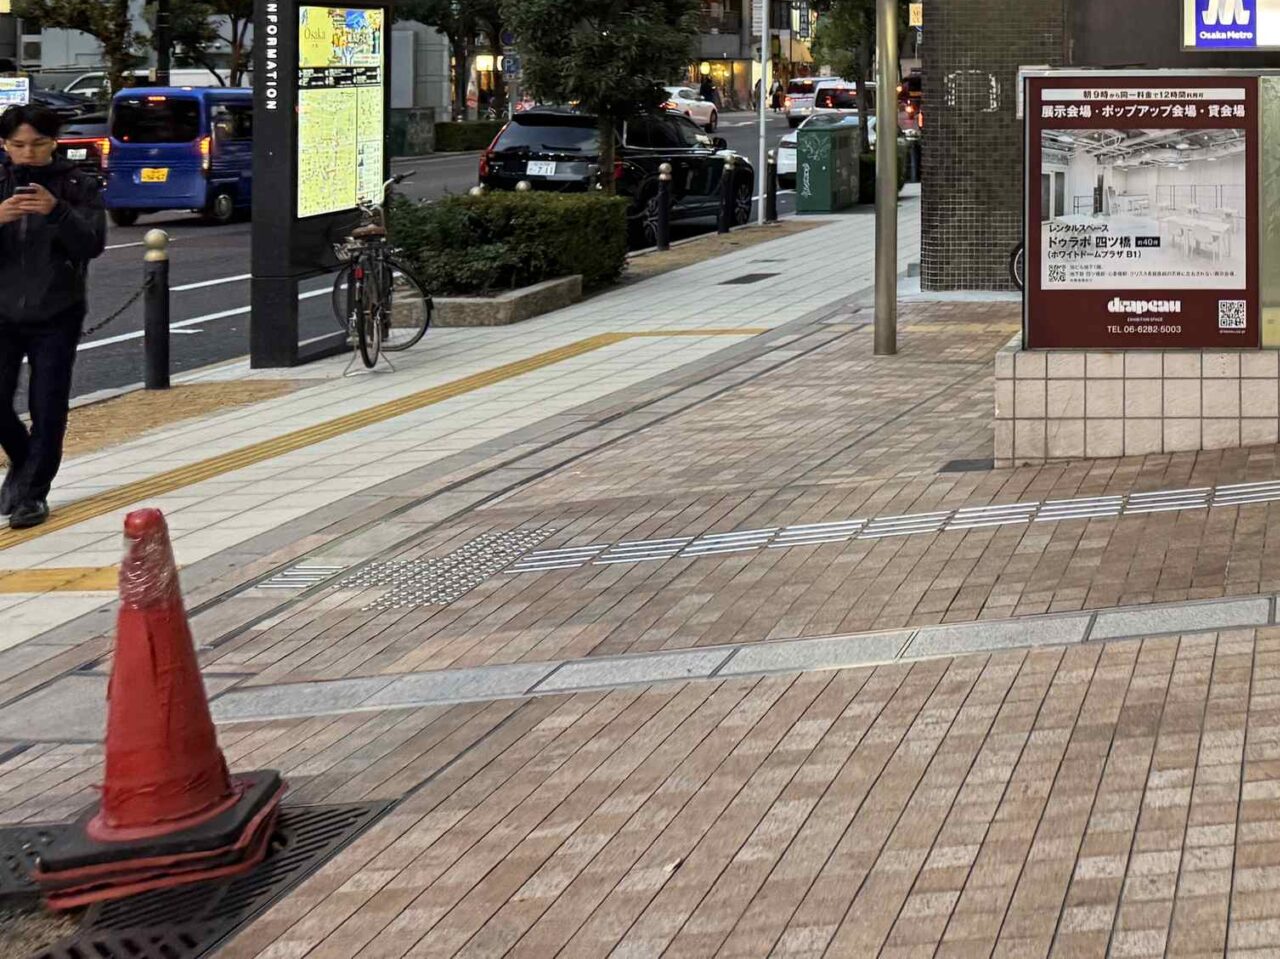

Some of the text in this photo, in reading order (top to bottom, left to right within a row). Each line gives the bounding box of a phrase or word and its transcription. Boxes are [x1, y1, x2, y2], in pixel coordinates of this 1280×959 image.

[1199, 30, 1254, 40] Osaka Metro
[1041, 104, 1246, 119] 展示会場・ポップアップ会場・貸会場
[1049, 224, 1109, 233] レンタルスペース
[1095, 235, 1132, 249] 四ツ橋
[1107, 297, 1181, 314] drapeau
[1107, 325, 1182, 334] TEL 06-6282-5003
